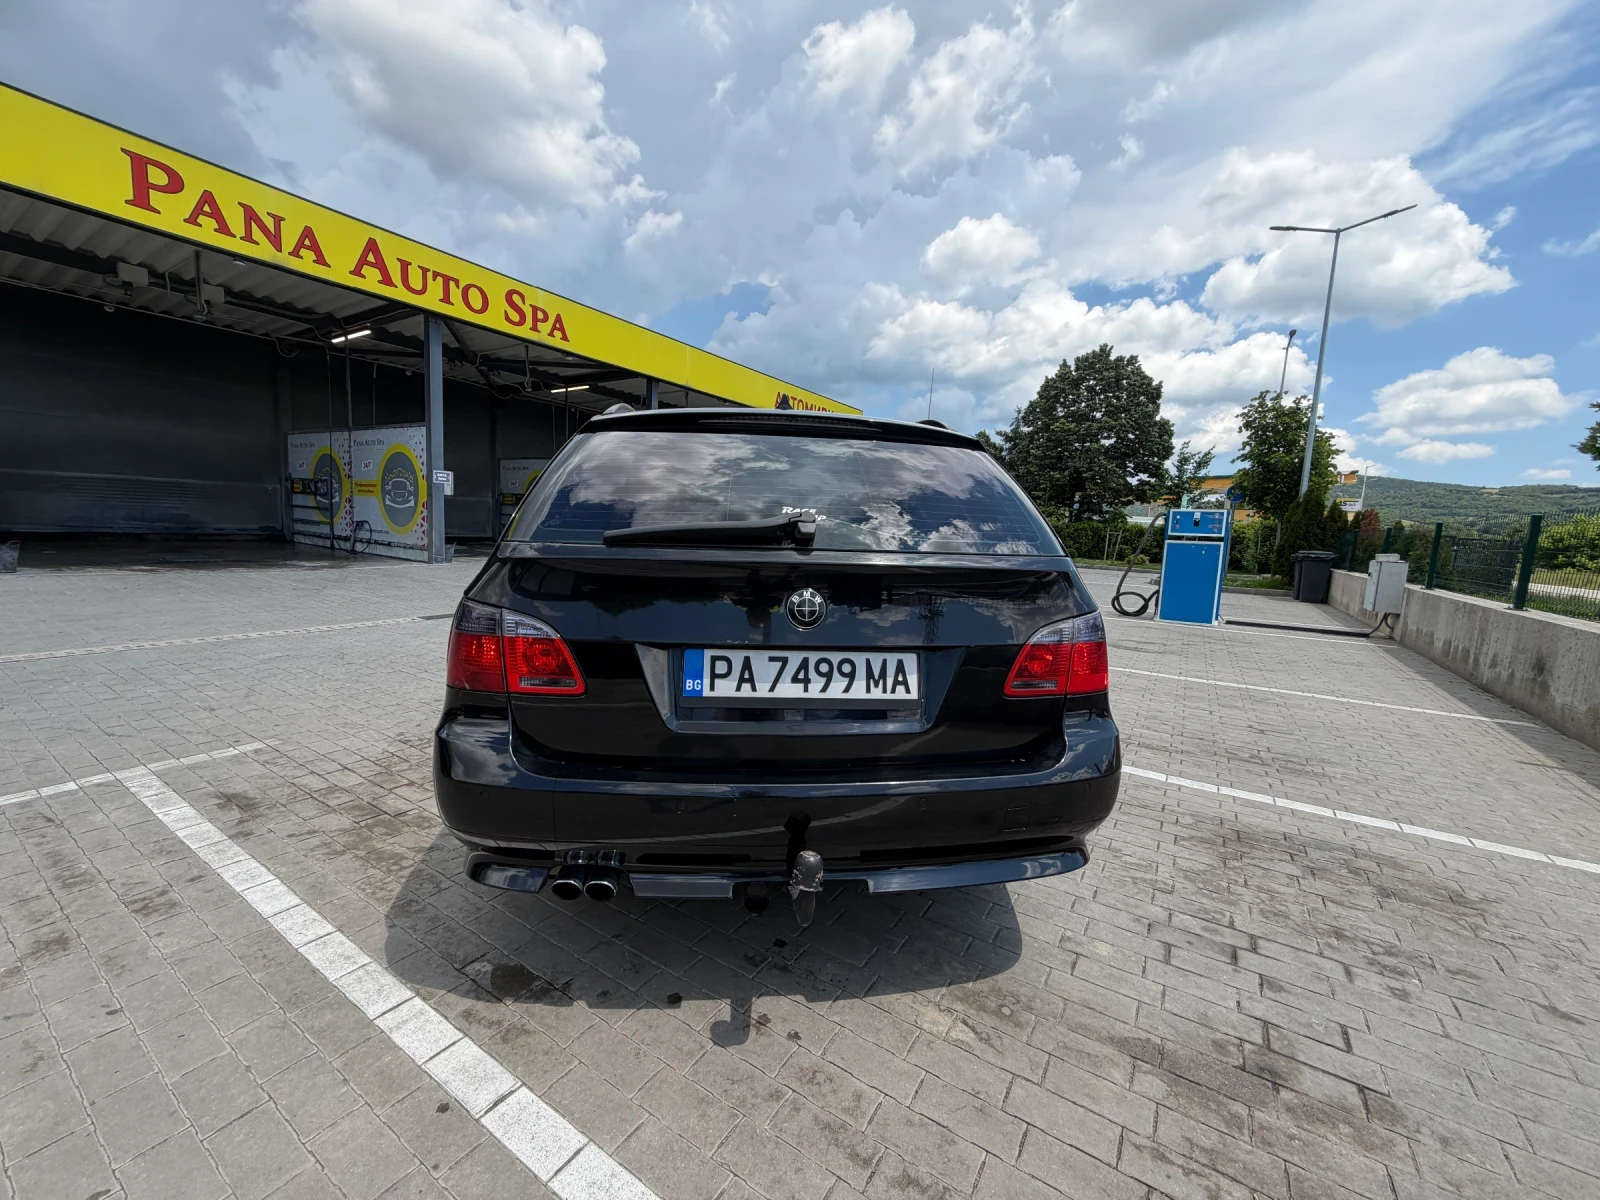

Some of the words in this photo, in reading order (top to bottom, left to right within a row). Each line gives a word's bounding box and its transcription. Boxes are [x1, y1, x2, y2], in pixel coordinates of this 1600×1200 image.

[120, 147, 331, 268] PANA
[349, 238, 490, 315] AUTO
[503, 289, 571, 342] SPA
[791, 590, 823, 603] BMW
[685, 679, 702, 691] BG
